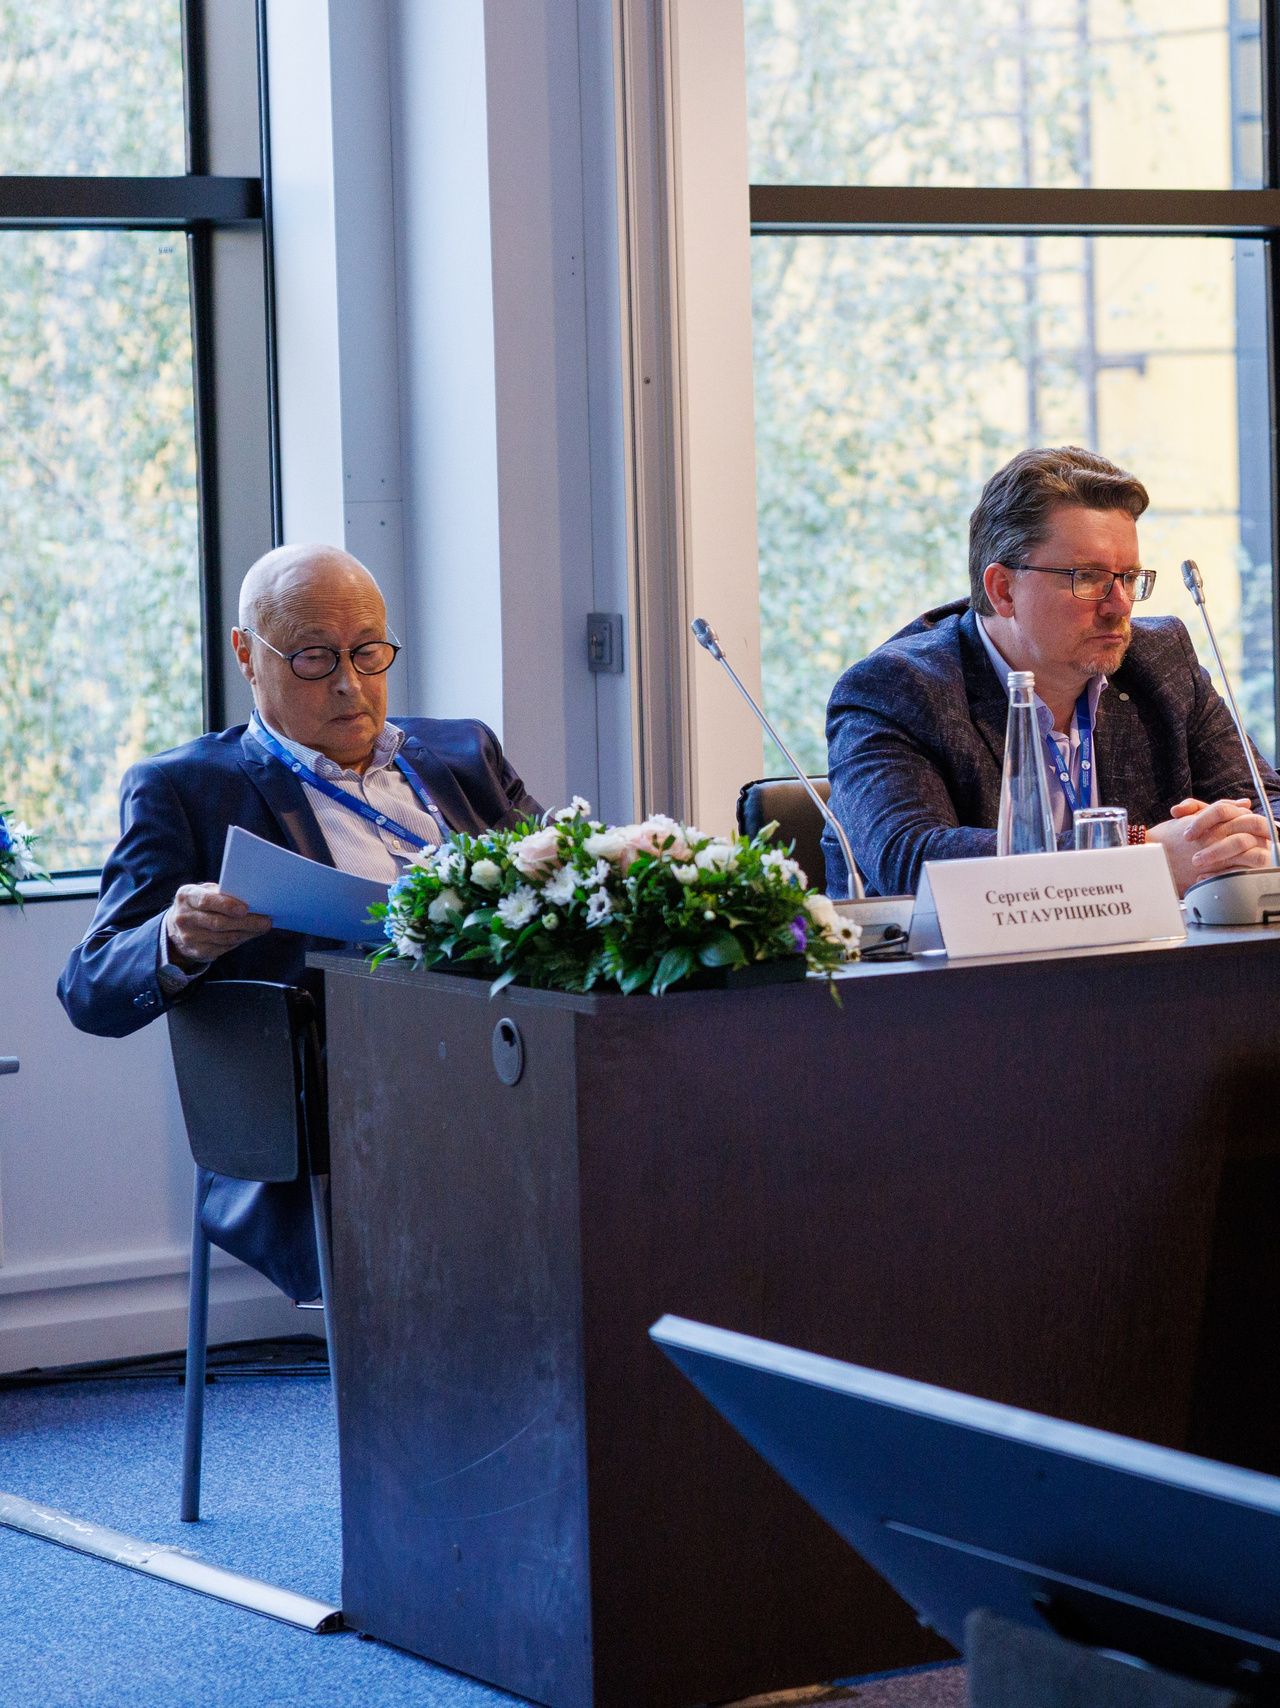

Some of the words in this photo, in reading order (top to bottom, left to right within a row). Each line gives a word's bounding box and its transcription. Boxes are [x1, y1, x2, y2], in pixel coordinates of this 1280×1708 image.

[985, 887, 1040, 906] Сергей
[1044, 883, 1125, 903] Сергеевич
[992, 901, 1132, 926] ТАТАУРЩИКОВ
